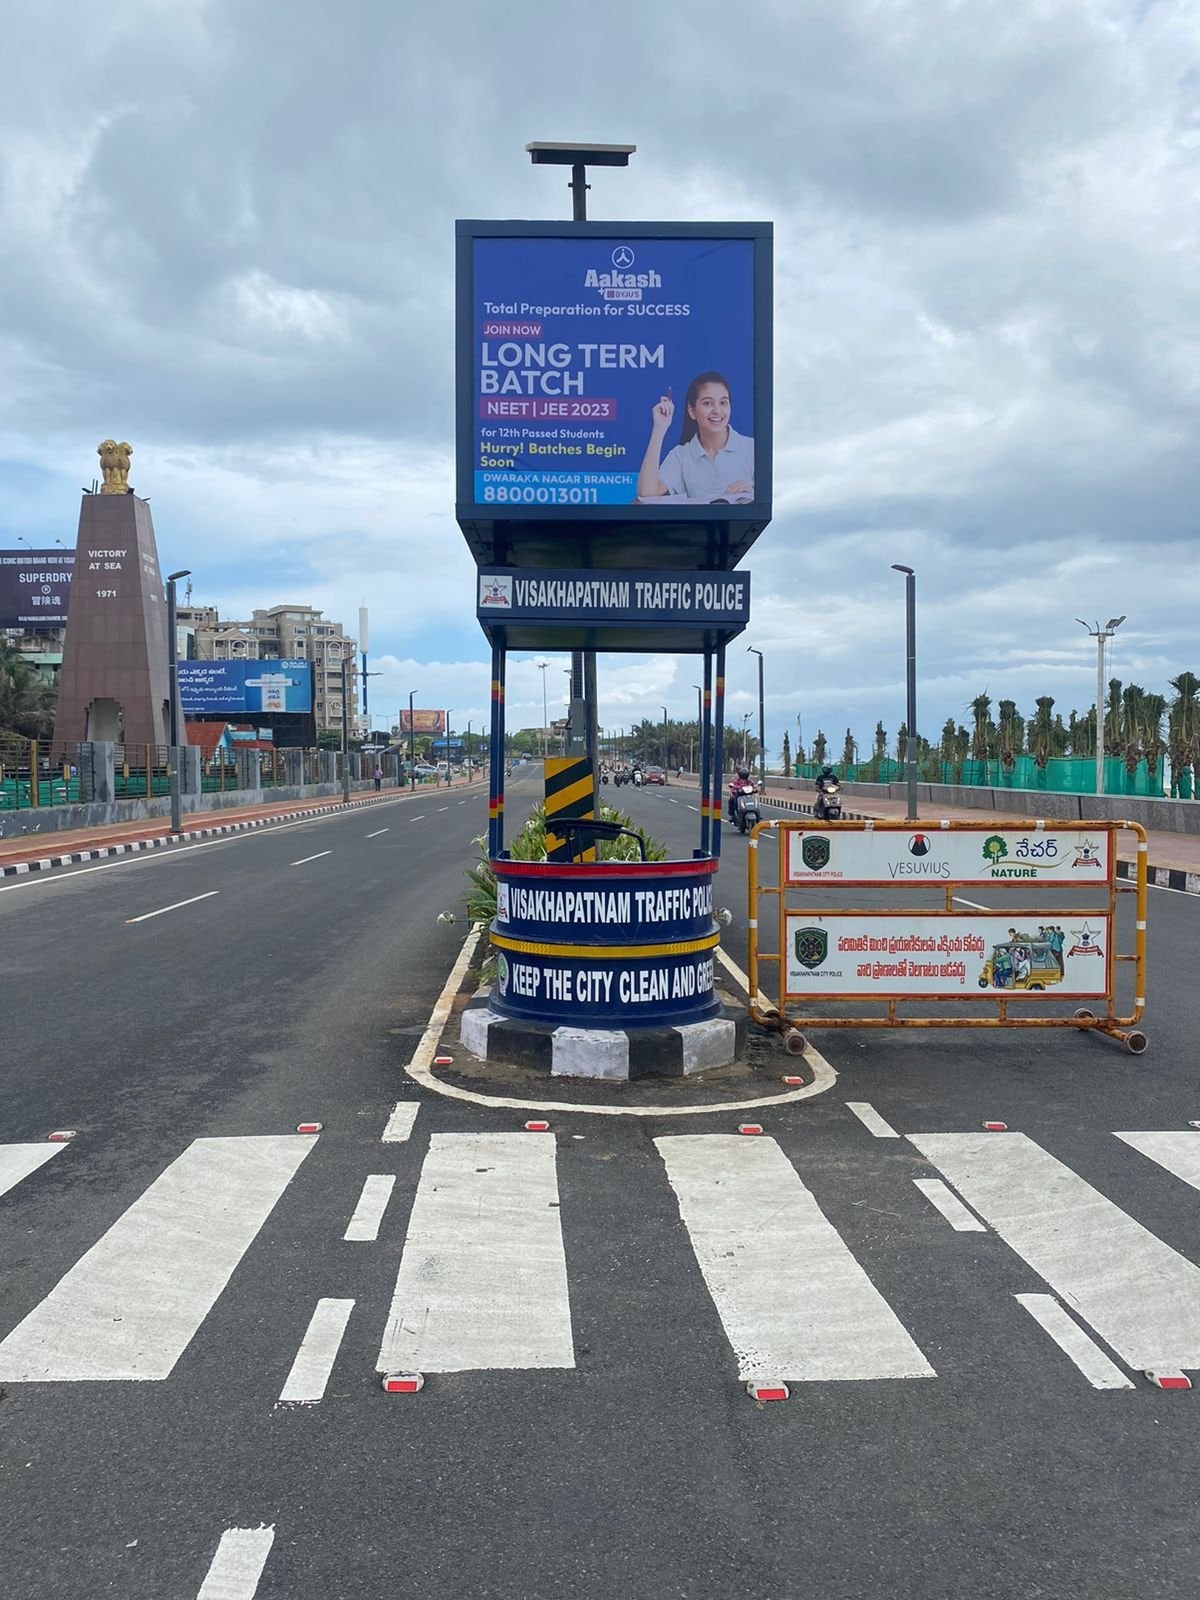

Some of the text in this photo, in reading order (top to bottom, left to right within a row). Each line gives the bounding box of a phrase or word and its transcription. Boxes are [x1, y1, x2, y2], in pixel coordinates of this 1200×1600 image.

[584, 269, 661, 288] Aakash
[484, 302, 690, 317] Total Preparation for SUCCESS
[484, 325, 541, 335] JOIN NOW
[482, 342, 664, 368] LONG TERM
[481, 370, 584, 395] BATCH
[487, 402, 610, 416] NEET JEE 2023
[481, 428, 604, 439] for 12th Passed Students
[480, 442, 626, 457] Hurry! Batches Begin
[480, 456, 514, 468] Soon
[483, 474, 632, 484] DWARAKA NAGAR BRANCH:
[484, 486, 598, 503] 8800013011
[88, 550, 127, 558] VICTORY
[89, 562, 122, 570] AT SEA
[19, 573, 72, 583] SUPERDRY
[96, 590, 116, 598] 1971
[515, 580, 743, 610] VISAKHAPATNAM TRAFFIC POLICE
[1016, 838, 1057, 857] నేచర్
[888, 862, 950, 879] VESUVIUS
[992, 869, 1037, 878] NATURE
[510, 888, 630, 924] VISAKHAPATNAM
[635, 888, 690, 922] TRAFFIC
[512, 958, 713, 1003] KEEP THE CITY CLEAN AND GREE
